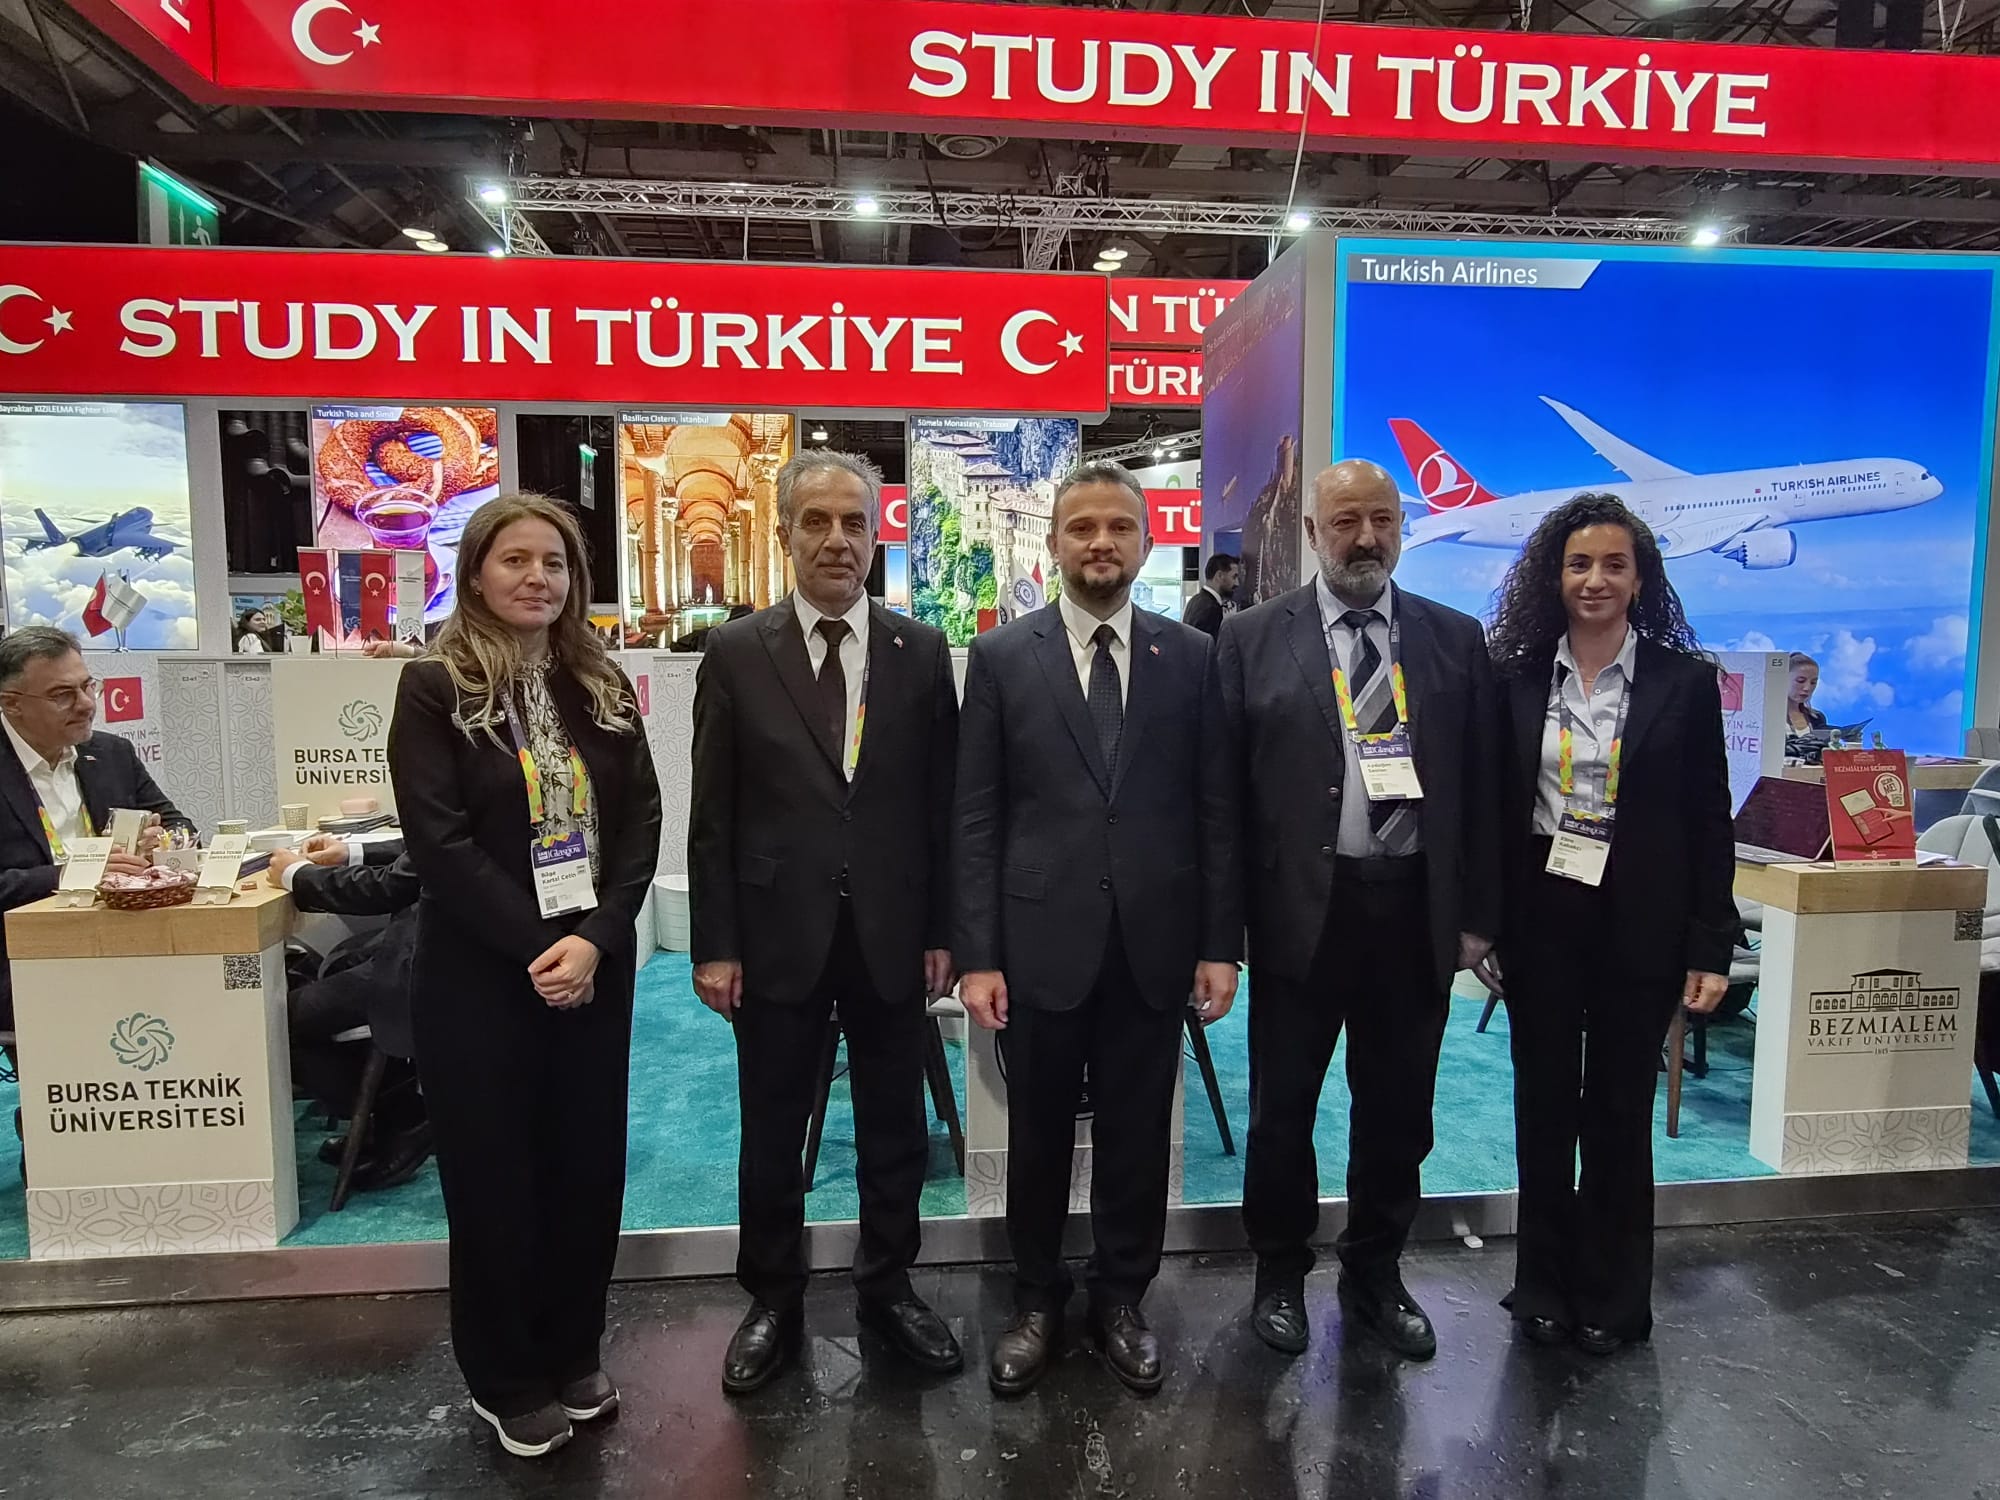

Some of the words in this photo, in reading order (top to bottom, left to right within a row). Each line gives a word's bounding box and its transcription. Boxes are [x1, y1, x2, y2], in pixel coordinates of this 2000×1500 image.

[909, 31, 1236, 110] STUDY
[1259, 50, 1352, 117] IN
[1378, 44, 1769, 138] TÜRKİYE
[1361, 259, 1445, 282] Turkish
[1451, 262, 1538, 285] Airlines
[1110, 296, 1138, 333] N
[1152, 288, 1231, 334] TÜ
[119, 299, 437, 362] STUDY
[460, 307, 552, 364] IN
[576, 297, 963, 375] TÜRKİYE
[317, 409, 344, 417] Turkish
[346, 410, 358, 418] Tea
[360, 410, 374, 418] and
[622, 414, 649, 422] Basilica
[1771, 477, 1825, 493] TURKISH
[1827, 471, 1881, 487] AIRLINES
[137, 730, 147, 739] IN
[1733, 720, 1743, 730] IN
[294, 748, 358, 764] BURSA
[1809, 1014, 1958, 1037] BEZMIALEM
[1808, 1037, 1852, 1047] VAKIF
[1863, 1033, 1957, 1046] UNIVERSITY
[47, 1081, 139, 1104] BURSA
[144, 1072, 243, 1100] TEKNİK
[49, 1101, 246, 1133] ÜNİVERSİTESİ
